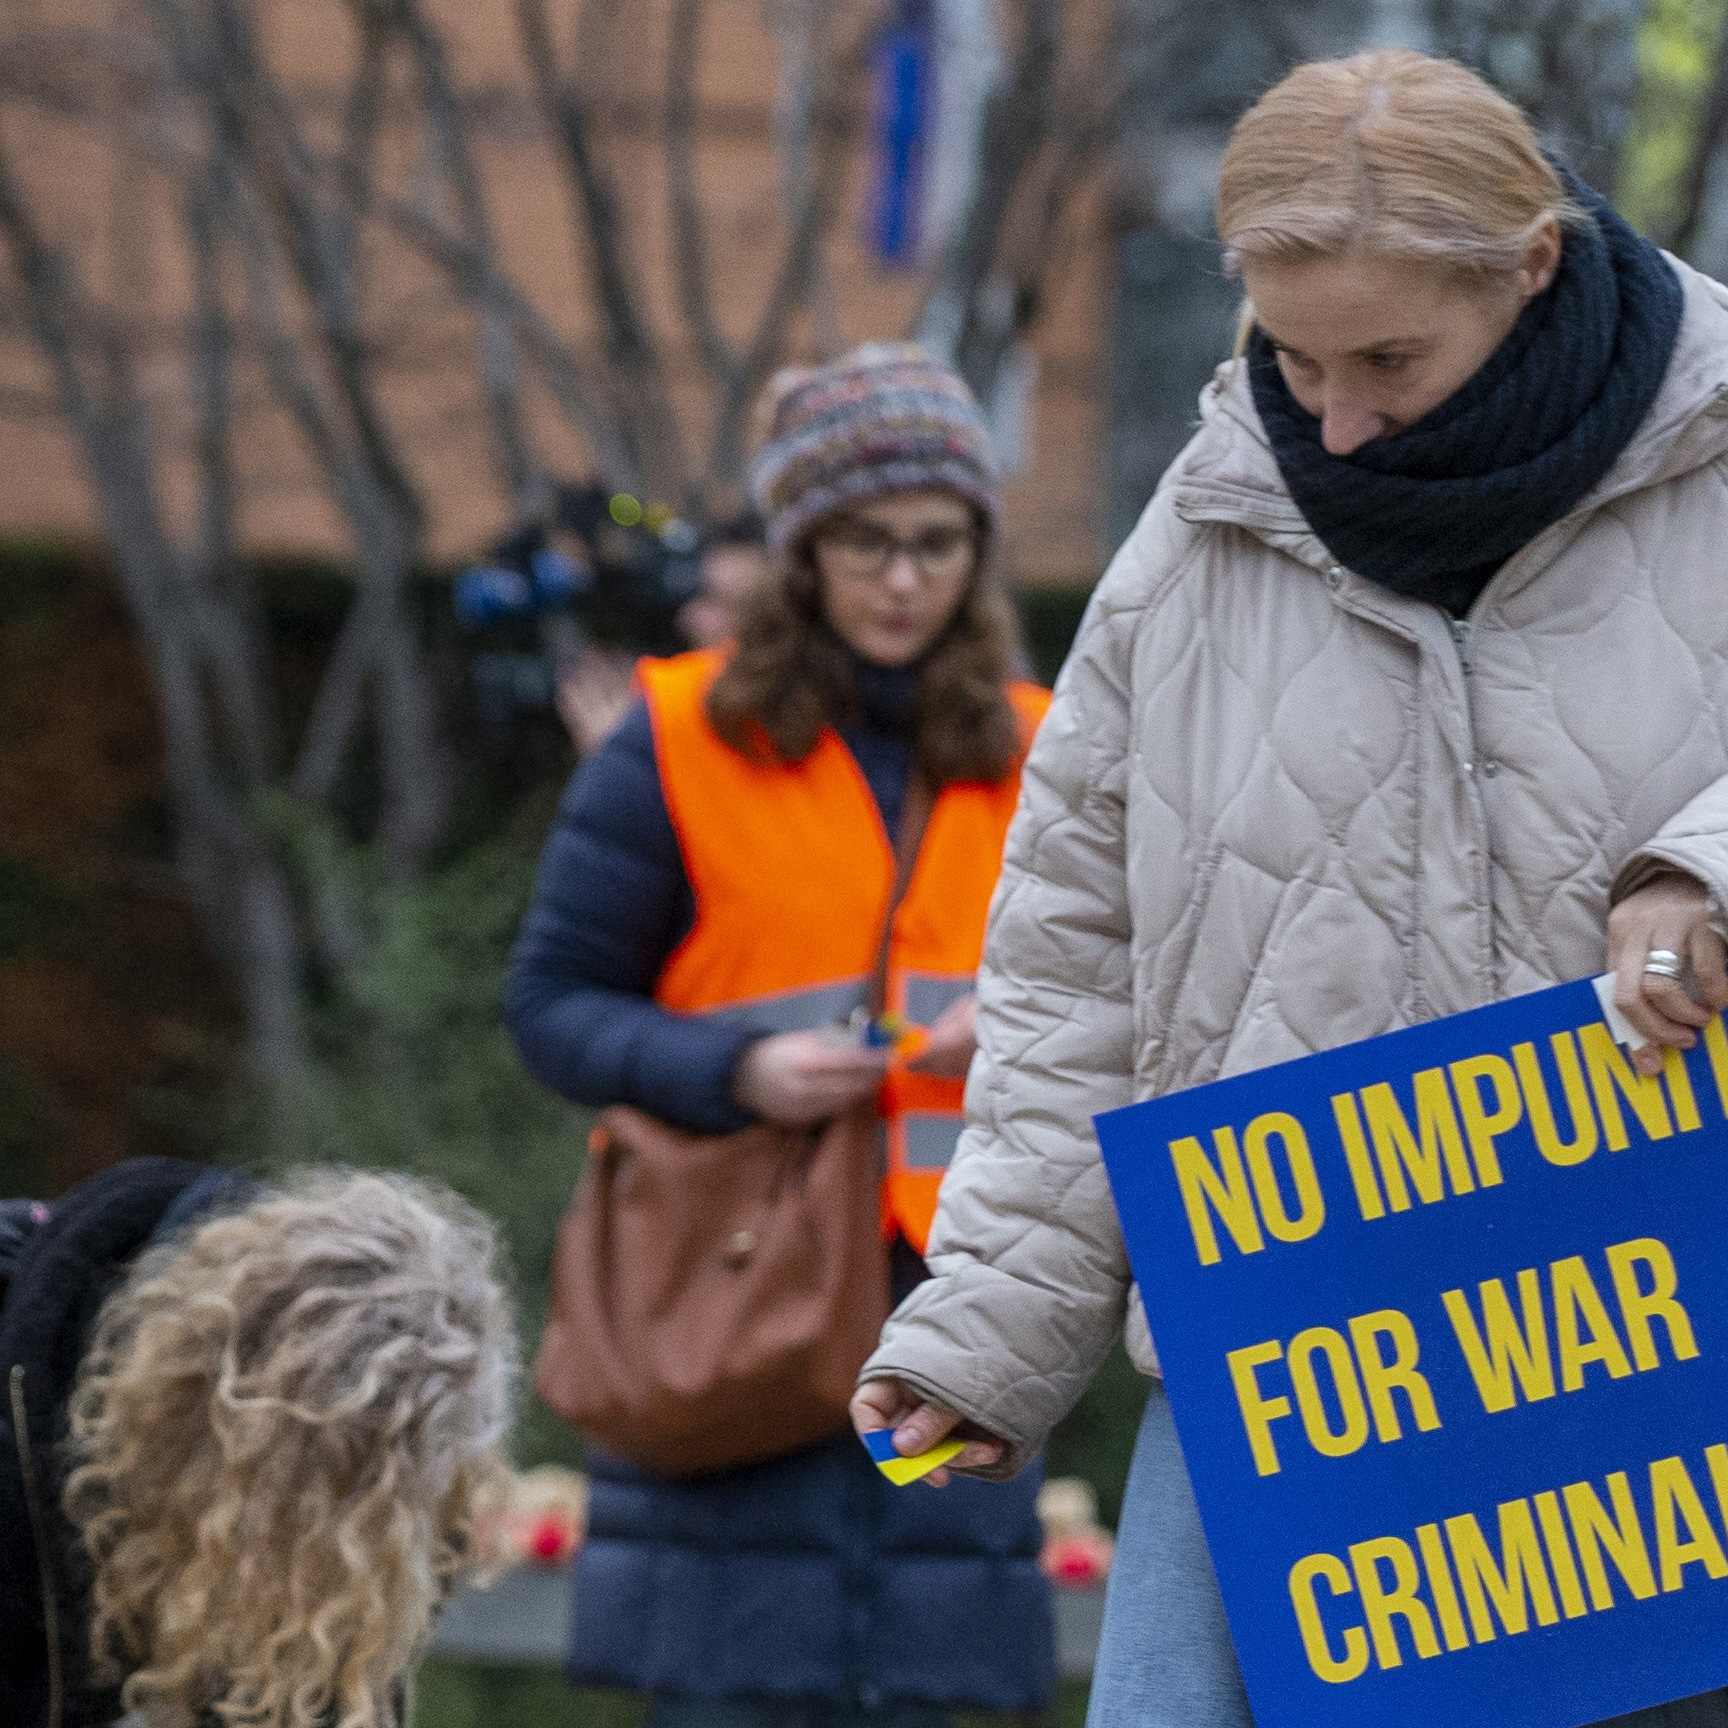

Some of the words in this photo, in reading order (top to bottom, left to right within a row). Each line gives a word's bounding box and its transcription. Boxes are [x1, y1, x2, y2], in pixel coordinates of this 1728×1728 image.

[1169, 1112, 1324, 1265] NO
[1228, 1309, 1441, 1476] FOR
[1442, 1238, 1698, 1412] WAR
